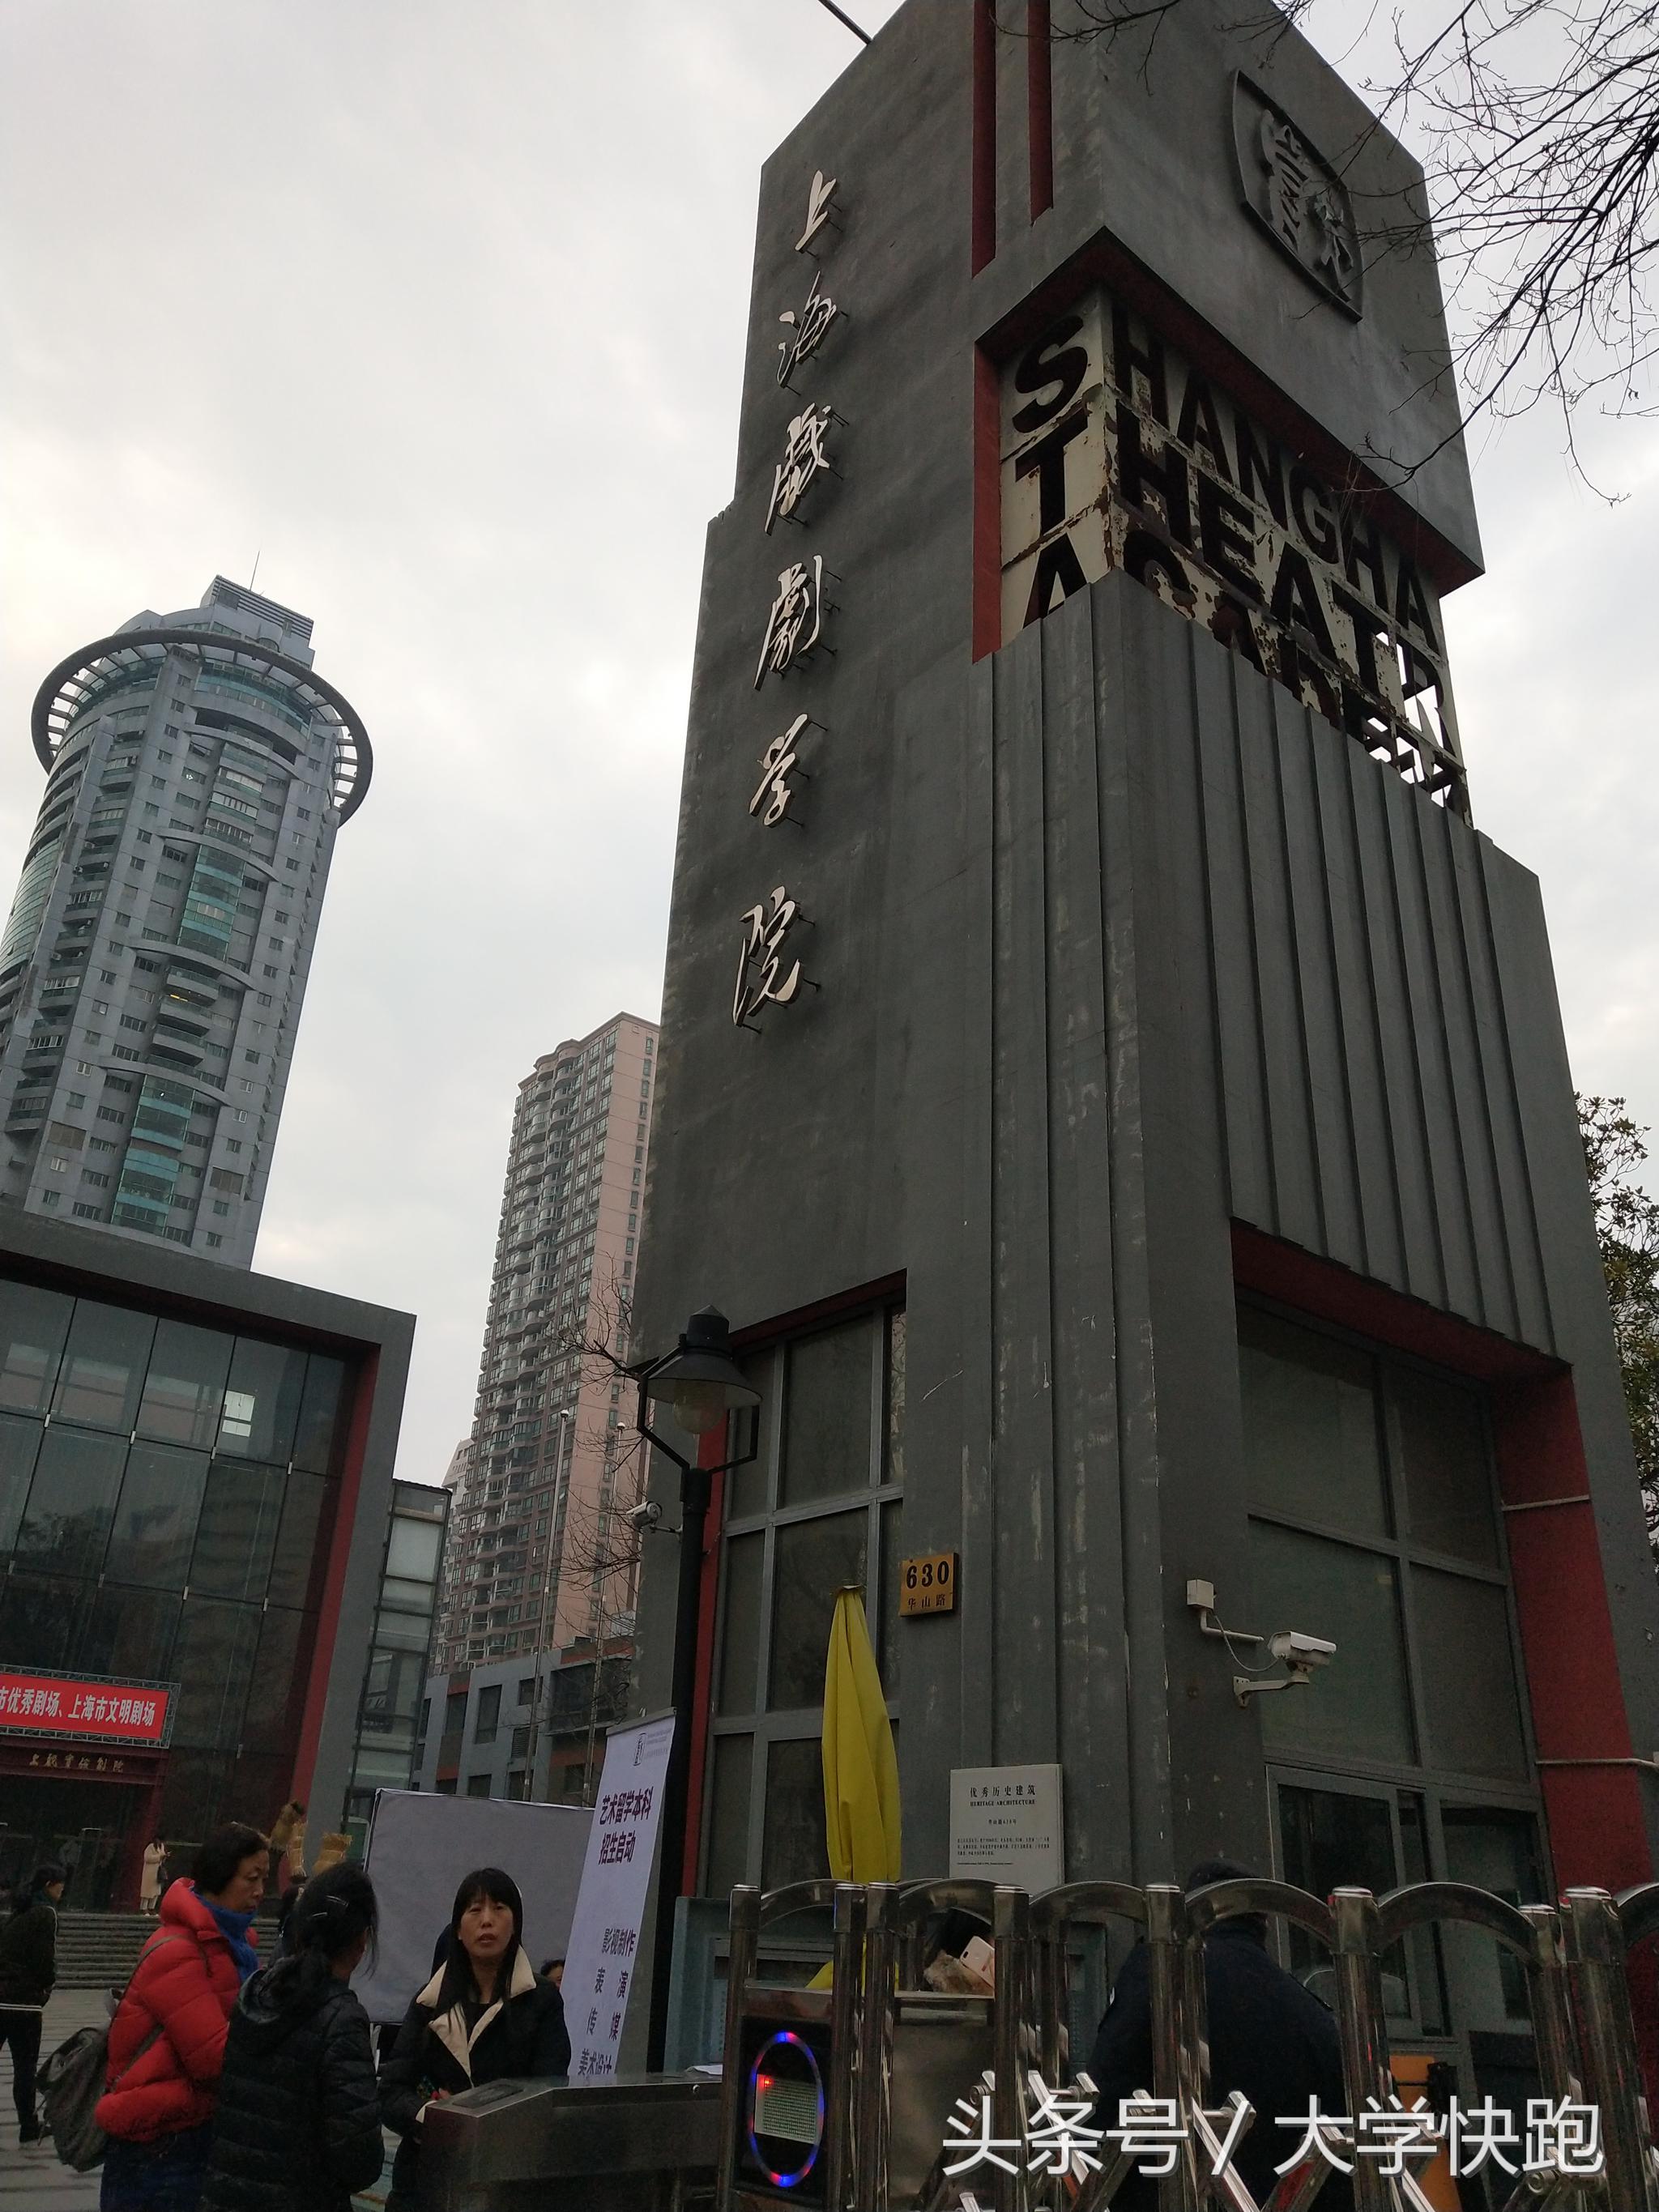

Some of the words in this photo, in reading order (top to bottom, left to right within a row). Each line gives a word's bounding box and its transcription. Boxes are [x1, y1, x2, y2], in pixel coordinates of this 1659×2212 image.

[906, 1560, 949, 1589] 630
[908, 1592, 946, 1611] 华山路
[970, 1784, 1036, 1798] 优秀历史建筑
[599, 1786, 655, 1826] 艺术留学本科
[598, 1830, 636, 1865] 招生启动
[602, 1928, 637, 1958] 影视制作
